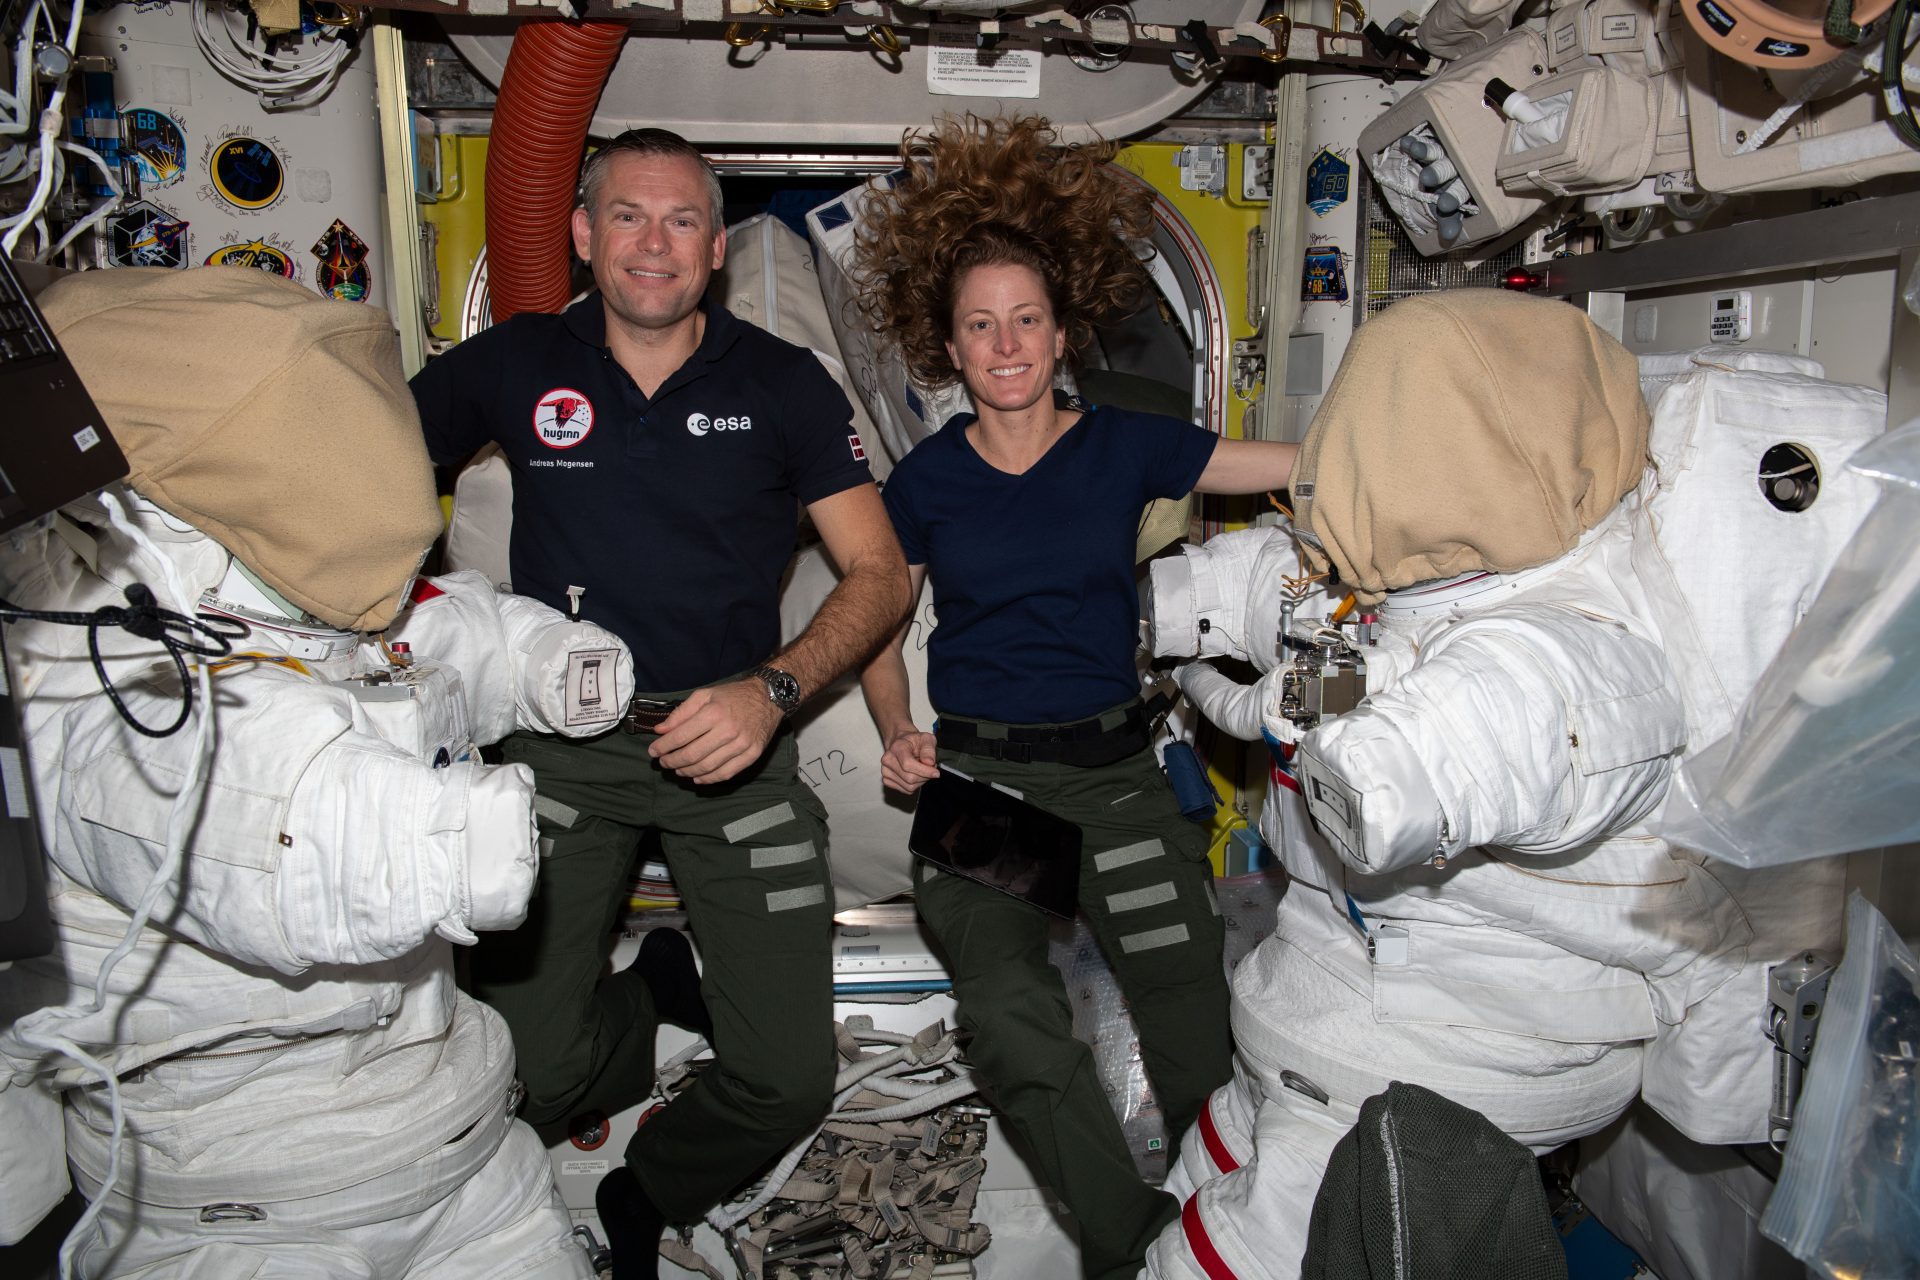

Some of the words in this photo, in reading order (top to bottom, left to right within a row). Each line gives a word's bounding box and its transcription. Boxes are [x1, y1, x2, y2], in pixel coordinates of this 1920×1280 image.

[137, 112, 157, 130] 68
[229, 146, 244, 155] XVI
[1323, 174, 1349, 193] 60
[713, 416, 752, 431] esa
[543, 427, 580, 440] huginn
[529, 459, 555, 467] Andreas
[556, 460, 594, 468] Mogensen
[799, 749, 858, 788] 172
